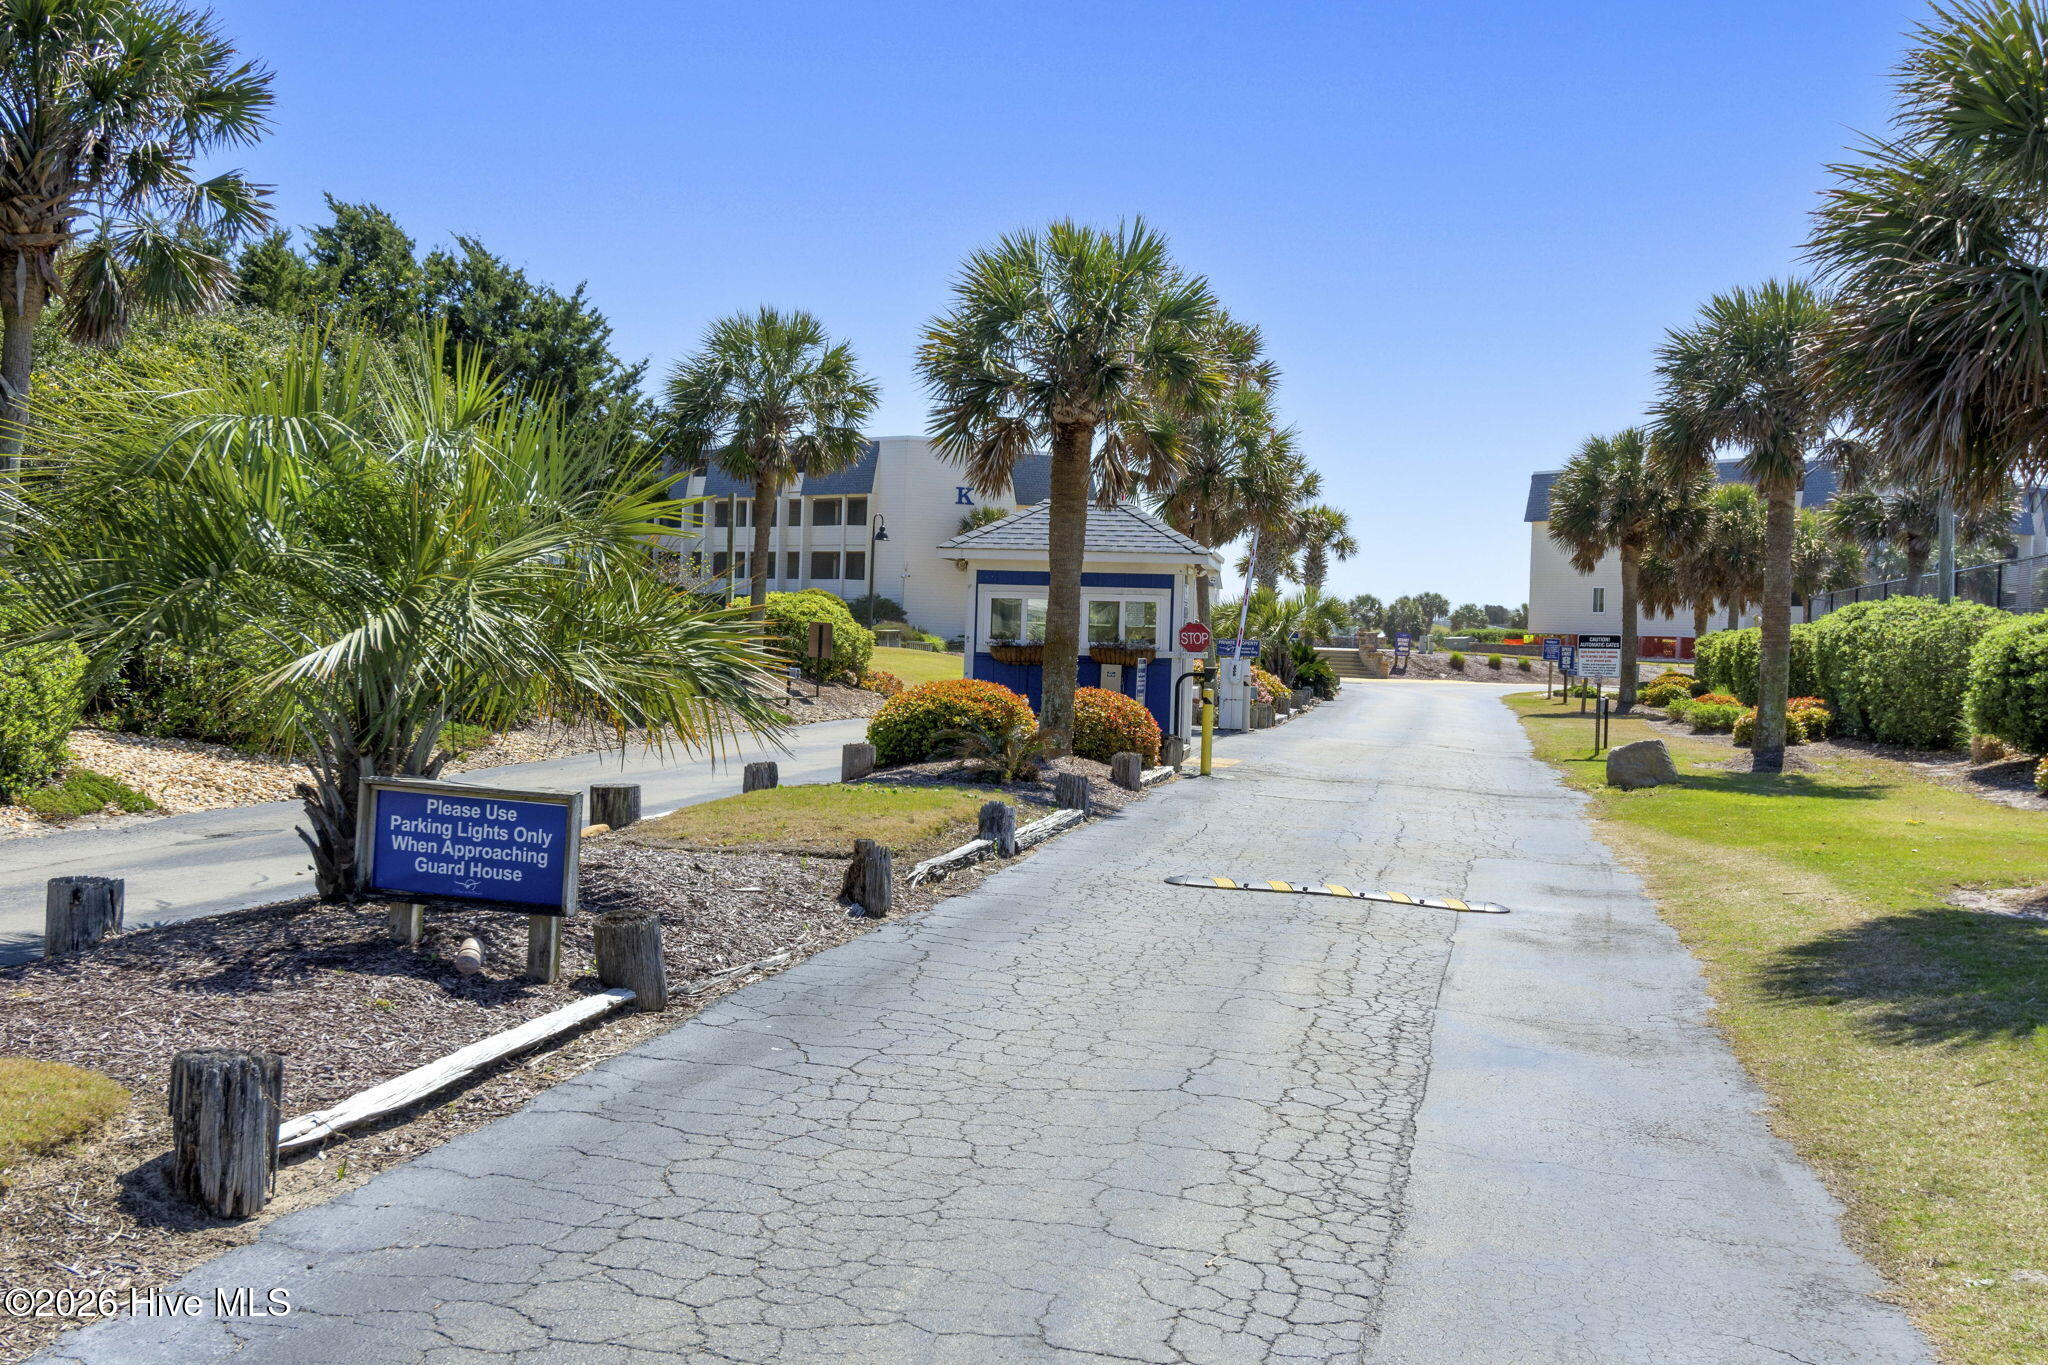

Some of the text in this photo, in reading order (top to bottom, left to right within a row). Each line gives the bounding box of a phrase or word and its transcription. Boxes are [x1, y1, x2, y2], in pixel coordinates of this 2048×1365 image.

[955, 486, 975, 505] K
[1180, 632, 1209, 645] STOP
[426, 798, 518, 822] Please Use
[390, 815, 552, 848] Parking Lights Only
[392, 834, 548, 868] When Approaching
[414, 856, 523, 882] Guard House
